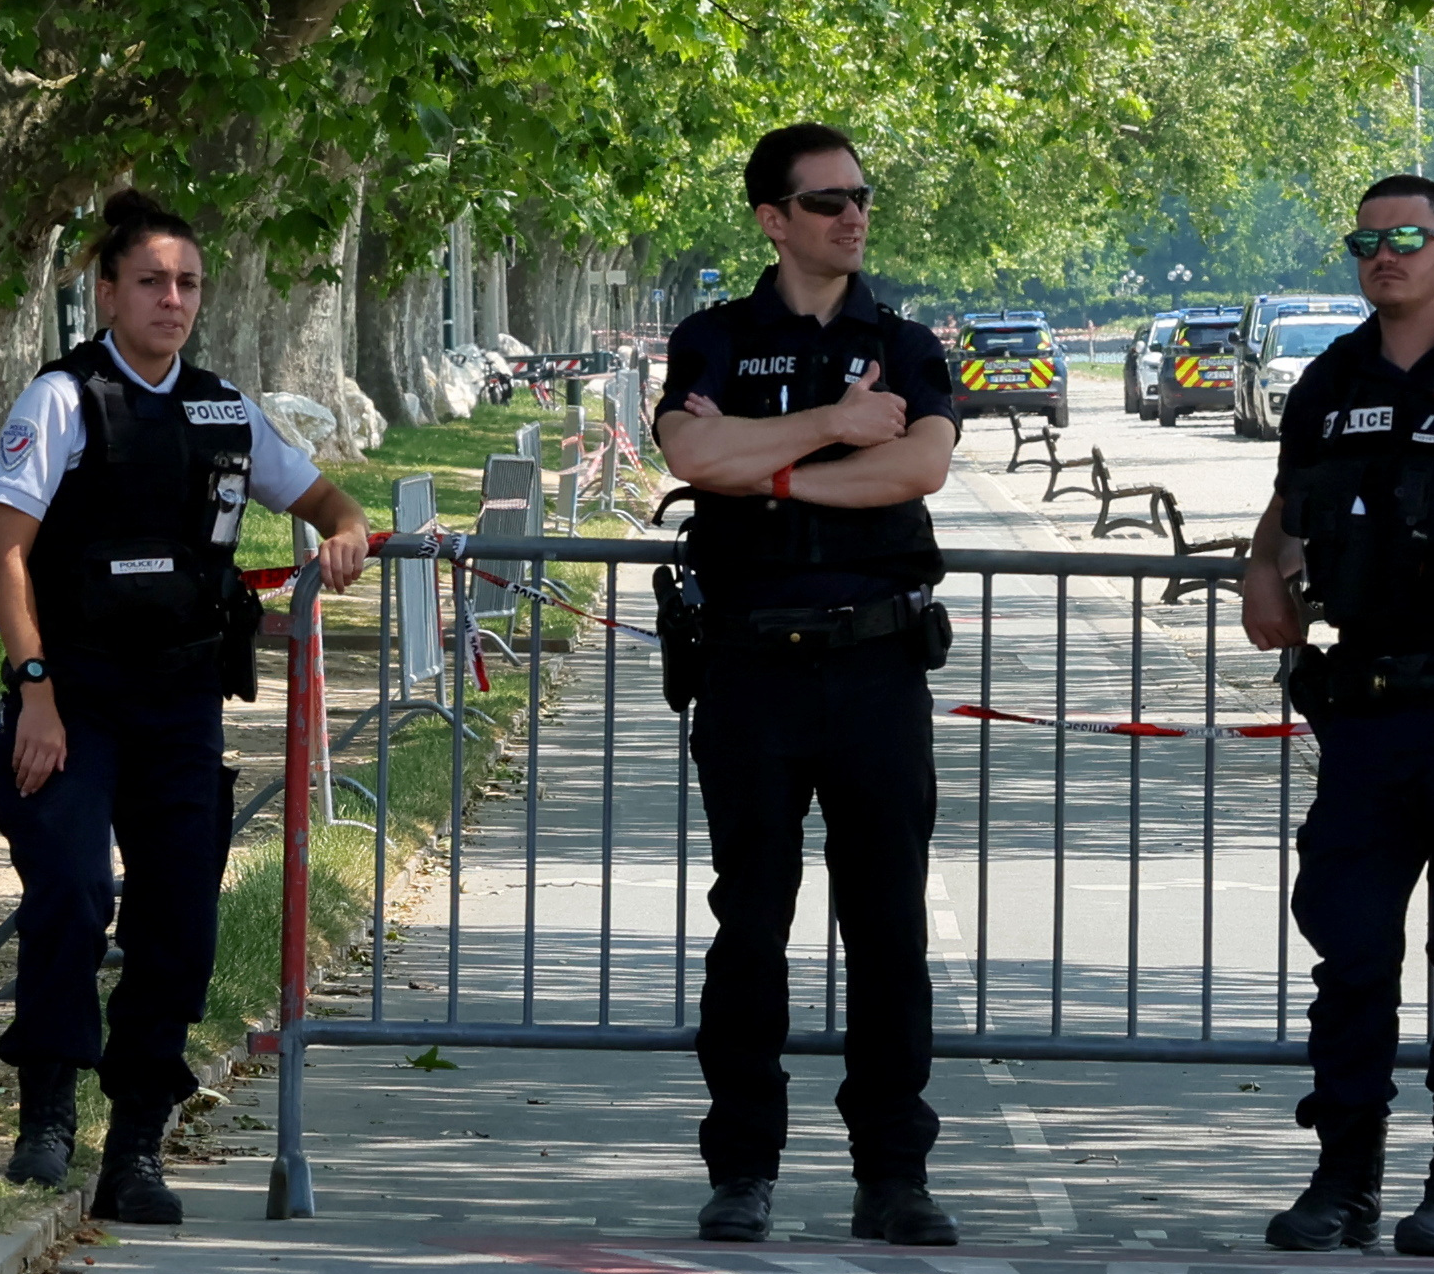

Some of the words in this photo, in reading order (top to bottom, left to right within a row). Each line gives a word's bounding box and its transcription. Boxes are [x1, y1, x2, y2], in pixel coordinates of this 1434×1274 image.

[738, 356, 796, 376] POLICE
[186, 405, 246, 421] POLICE
[1324, 411, 1391, 434] PLICE
